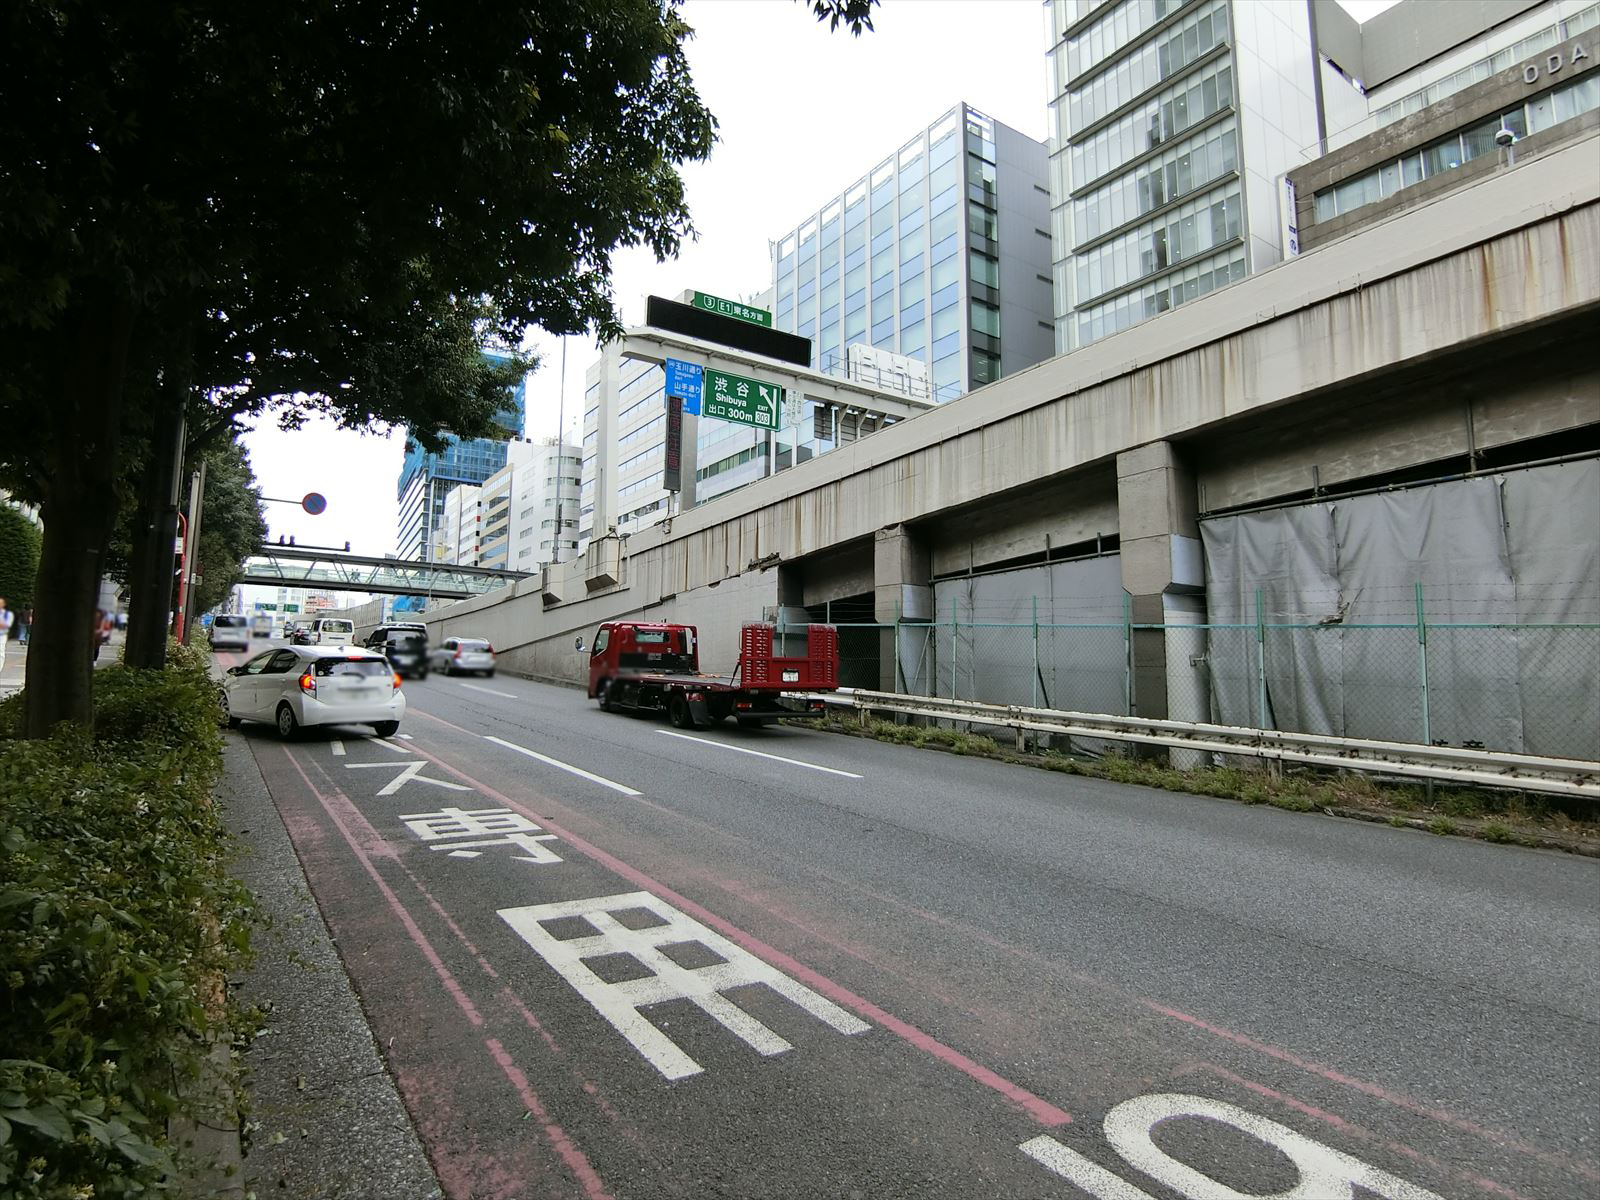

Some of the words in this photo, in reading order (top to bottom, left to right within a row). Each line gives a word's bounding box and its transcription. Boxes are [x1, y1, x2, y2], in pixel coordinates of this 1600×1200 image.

[1524, 43, 1589, 84] ODA
[719, 302, 731, 312] E1
[733, 304, 764, 322] 東名方面
[714, 376, 749, 398] 渋谷
[715, 392, 747, 408] Shibuya
[757, 404, 769, 412] EXIT
[708, 404, 726, 416] 出口
[727, 407, 753, 423] 300m
[756, 412, 769, 424] 303
